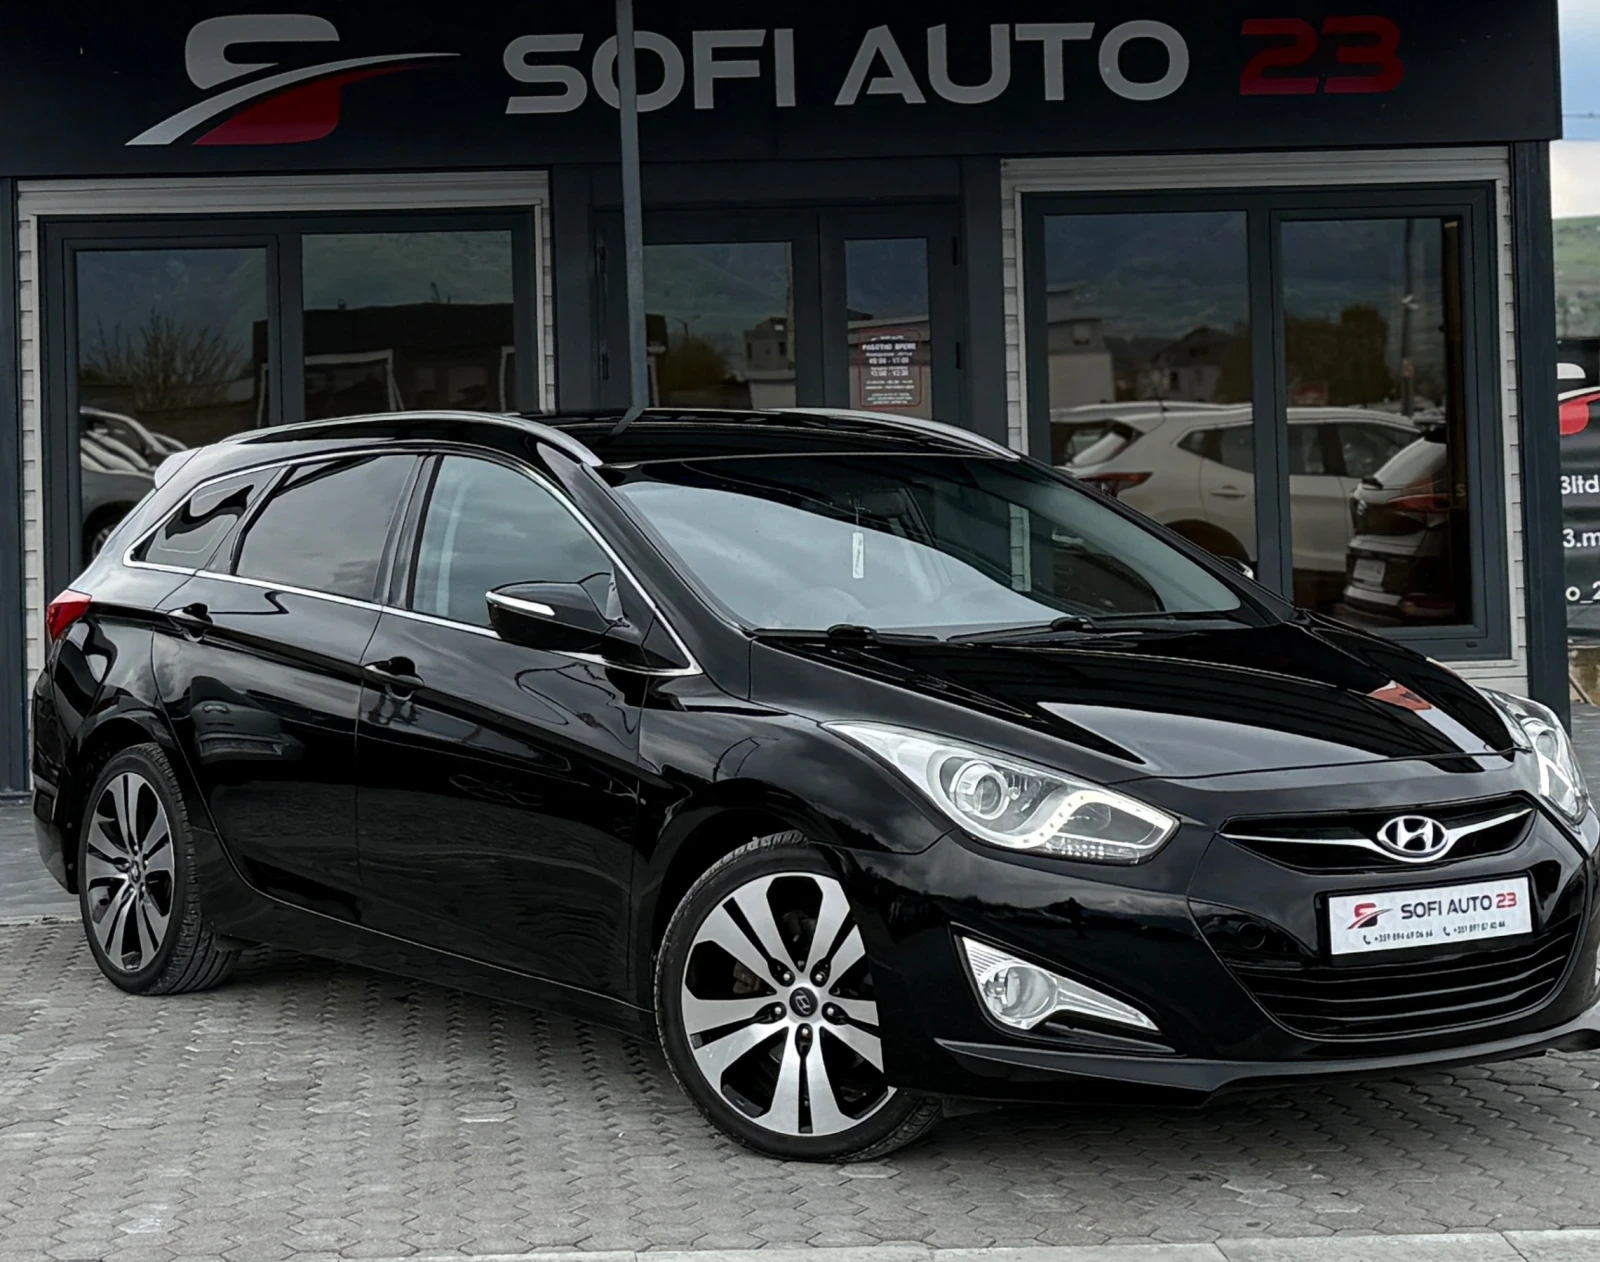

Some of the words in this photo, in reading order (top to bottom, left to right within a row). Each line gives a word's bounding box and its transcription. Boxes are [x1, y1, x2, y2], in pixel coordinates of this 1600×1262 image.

[504, 28, 796, 115] SOFI
[834, 20, 1190, 106] AUTO
[1239, 17, 1403, 95] 23
[1400, 901, 1442, 920] SOFI
[1446, 894, 1493, 916] AUTO
[1495, 892, 1518, 909] 23
